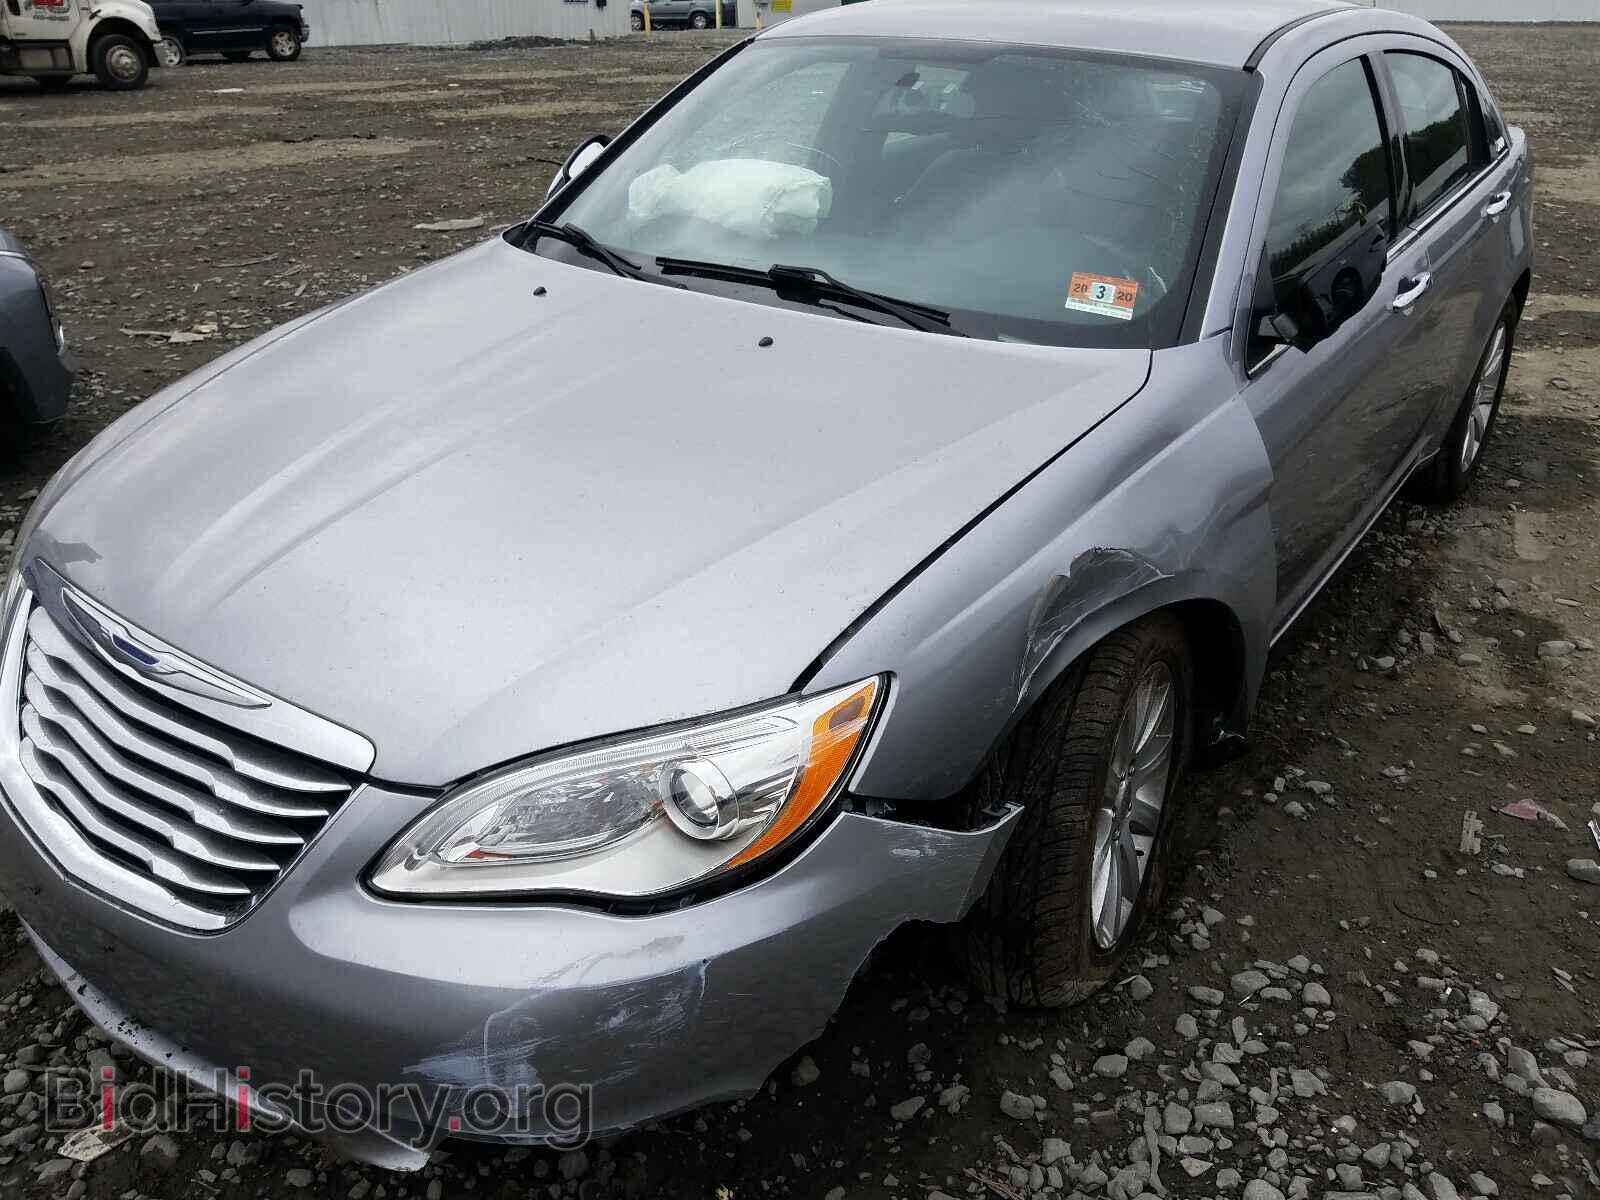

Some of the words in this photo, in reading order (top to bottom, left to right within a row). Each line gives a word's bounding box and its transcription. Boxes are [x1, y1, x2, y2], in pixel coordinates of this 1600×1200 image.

[1073, 283, 1088, 293] 20
[1096, 285, 1106, 300] 3
[1117, 291, 1132, 302] 20
